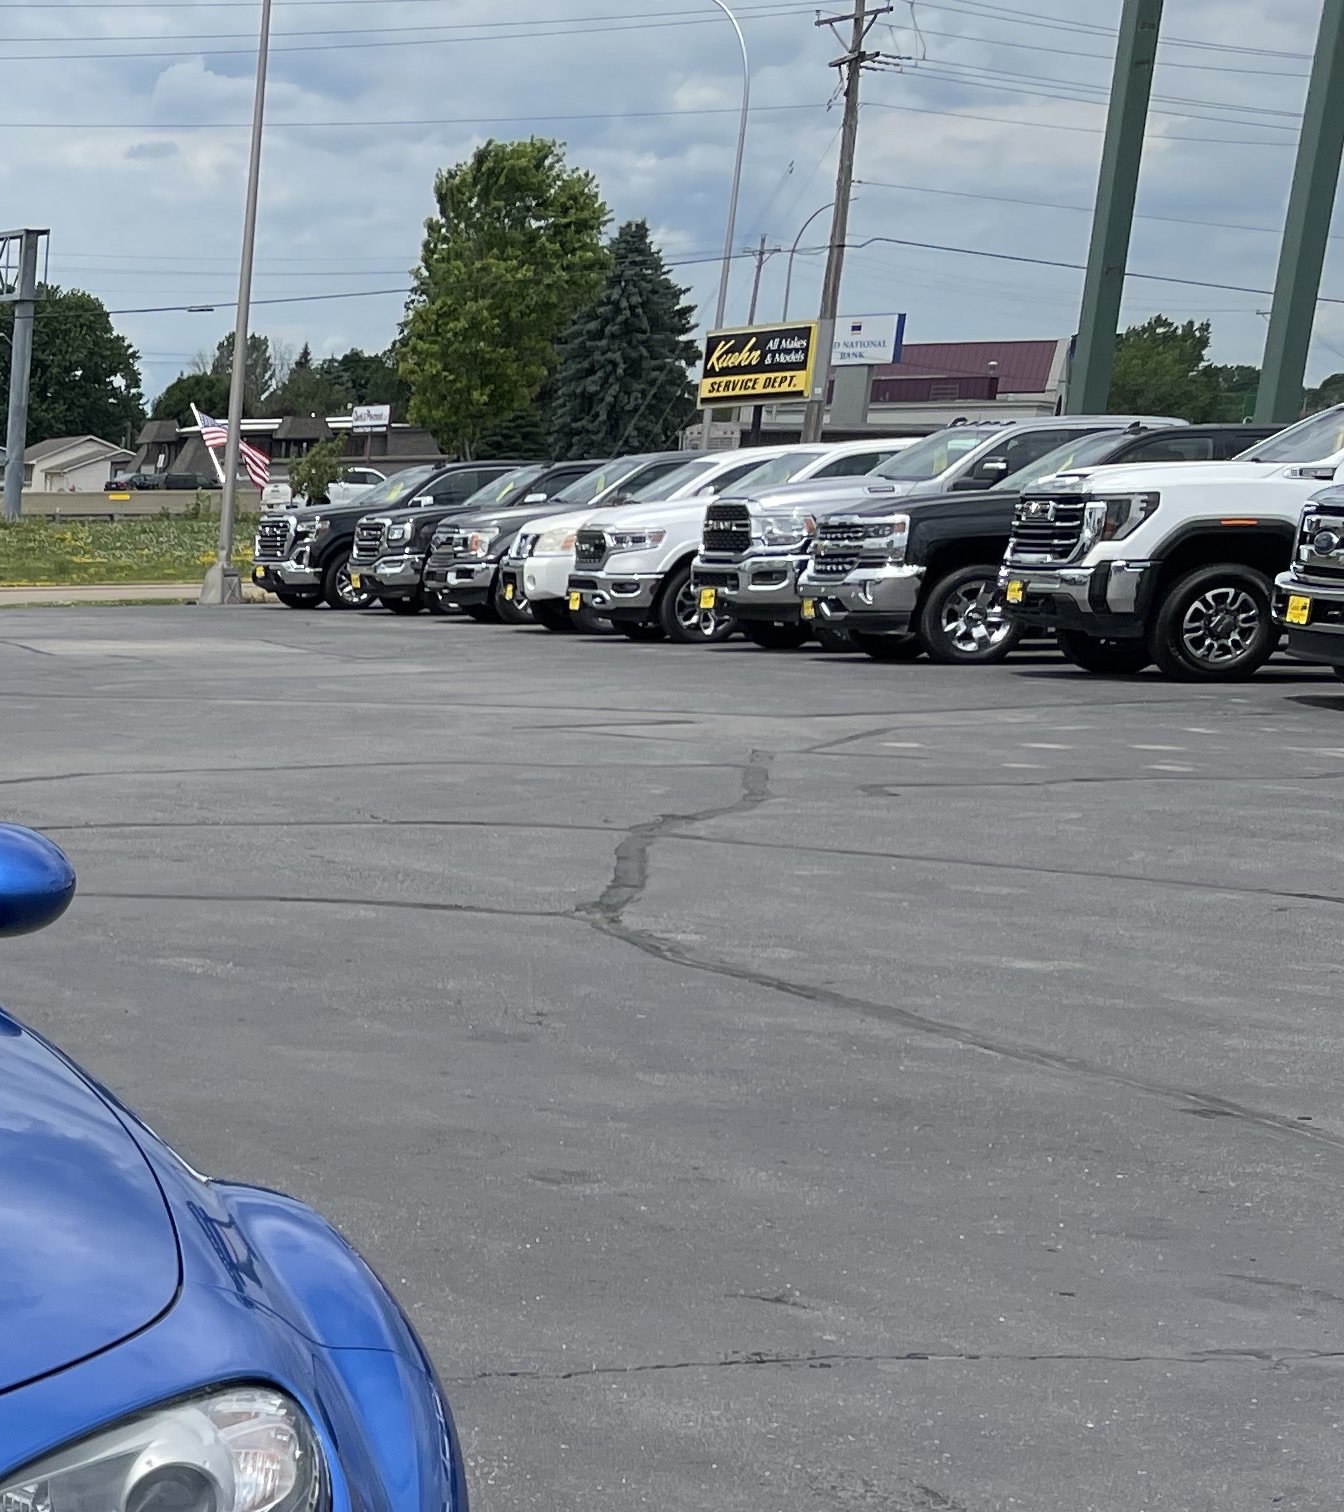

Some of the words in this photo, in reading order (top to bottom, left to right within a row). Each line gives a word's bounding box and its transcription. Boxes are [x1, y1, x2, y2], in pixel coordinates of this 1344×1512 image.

[765, 337, 780, 350] All
[780, 335, 807, 349] Makes
[842, 339, 888, 349] NATIONAL
[706, 336, 762, 372] Kuehn
[764, 353, 772, 365] &
[773, 350, 805, 364] Models
[839, 351, 864, 360] BANK
[708, 377, 759, 394] SERVICE
[763, 374, 797, 389] DEPT.
